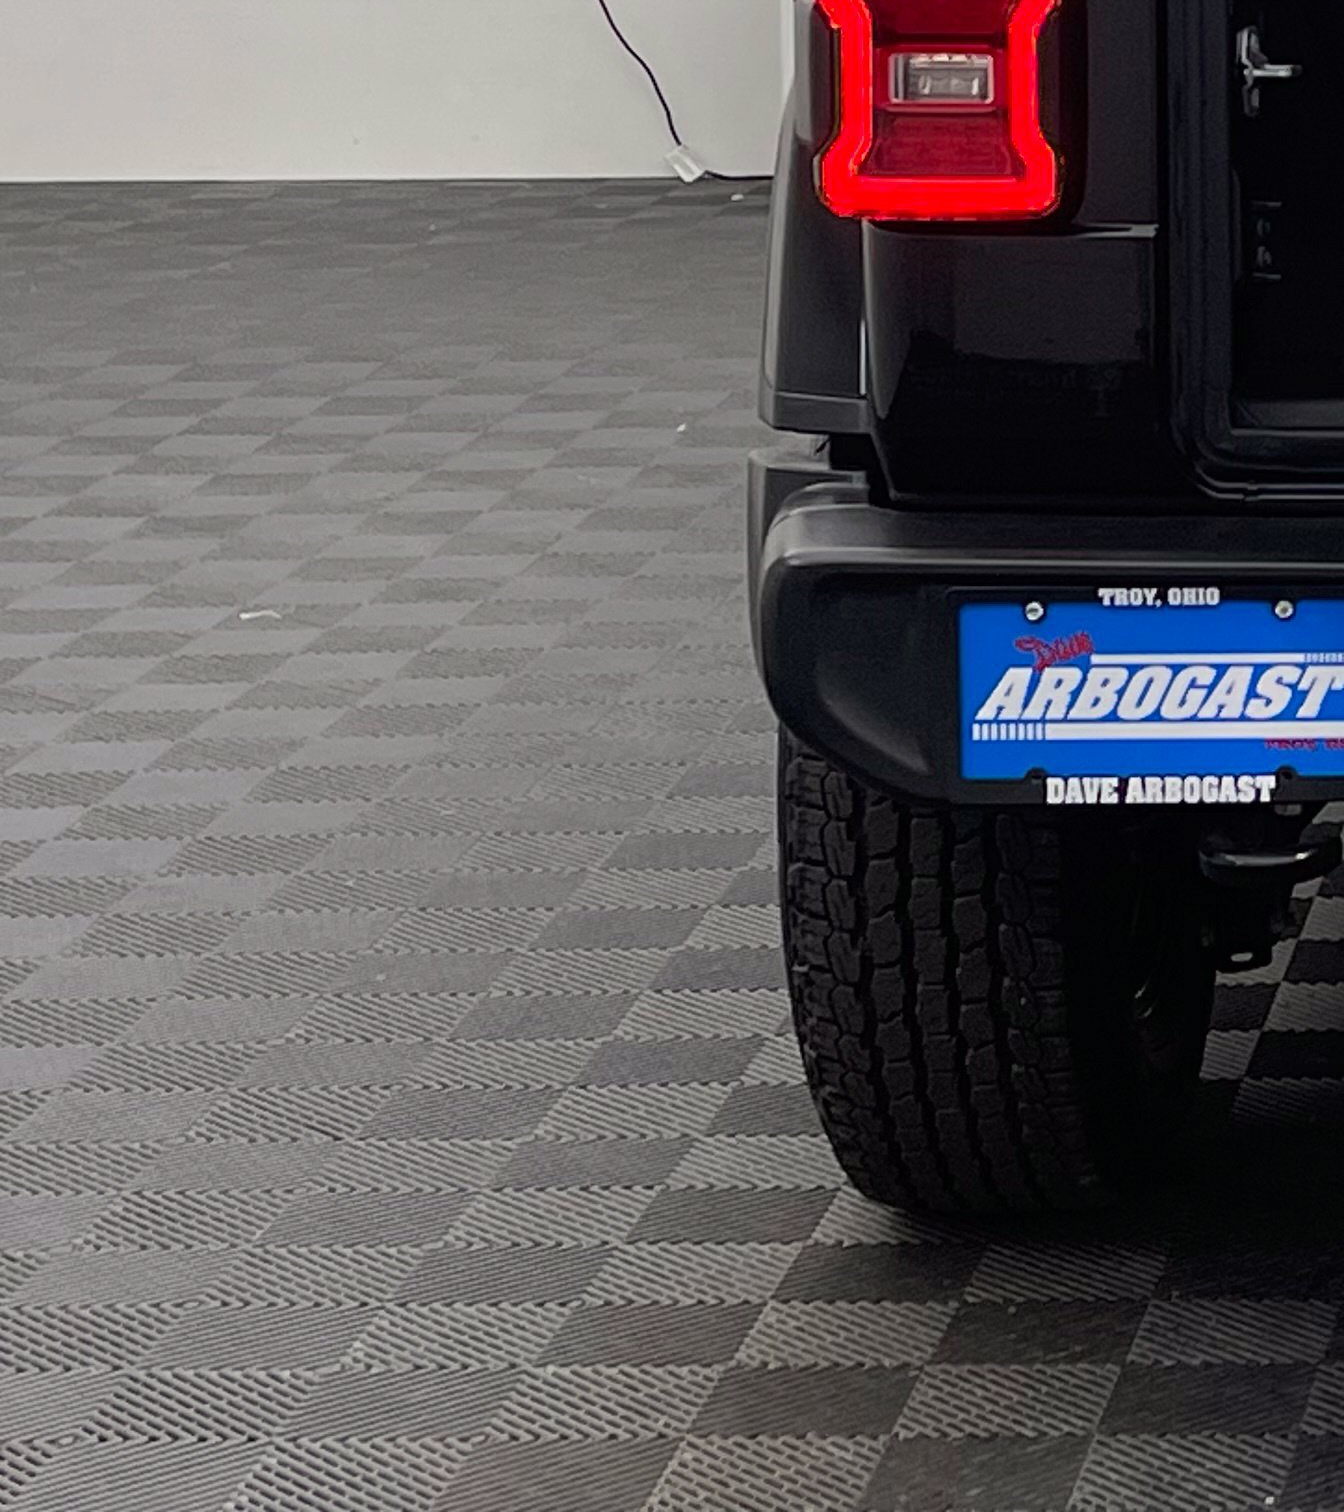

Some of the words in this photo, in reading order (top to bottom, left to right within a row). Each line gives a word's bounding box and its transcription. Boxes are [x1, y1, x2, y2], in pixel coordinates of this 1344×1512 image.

[1098, 587, 1162, 608] TROY,
[1167, 587, 1220, 606] OHIO
[1046, 776, 1119, 804] DAVE
[1125, 775, 1277, 803] ARBOGAST
